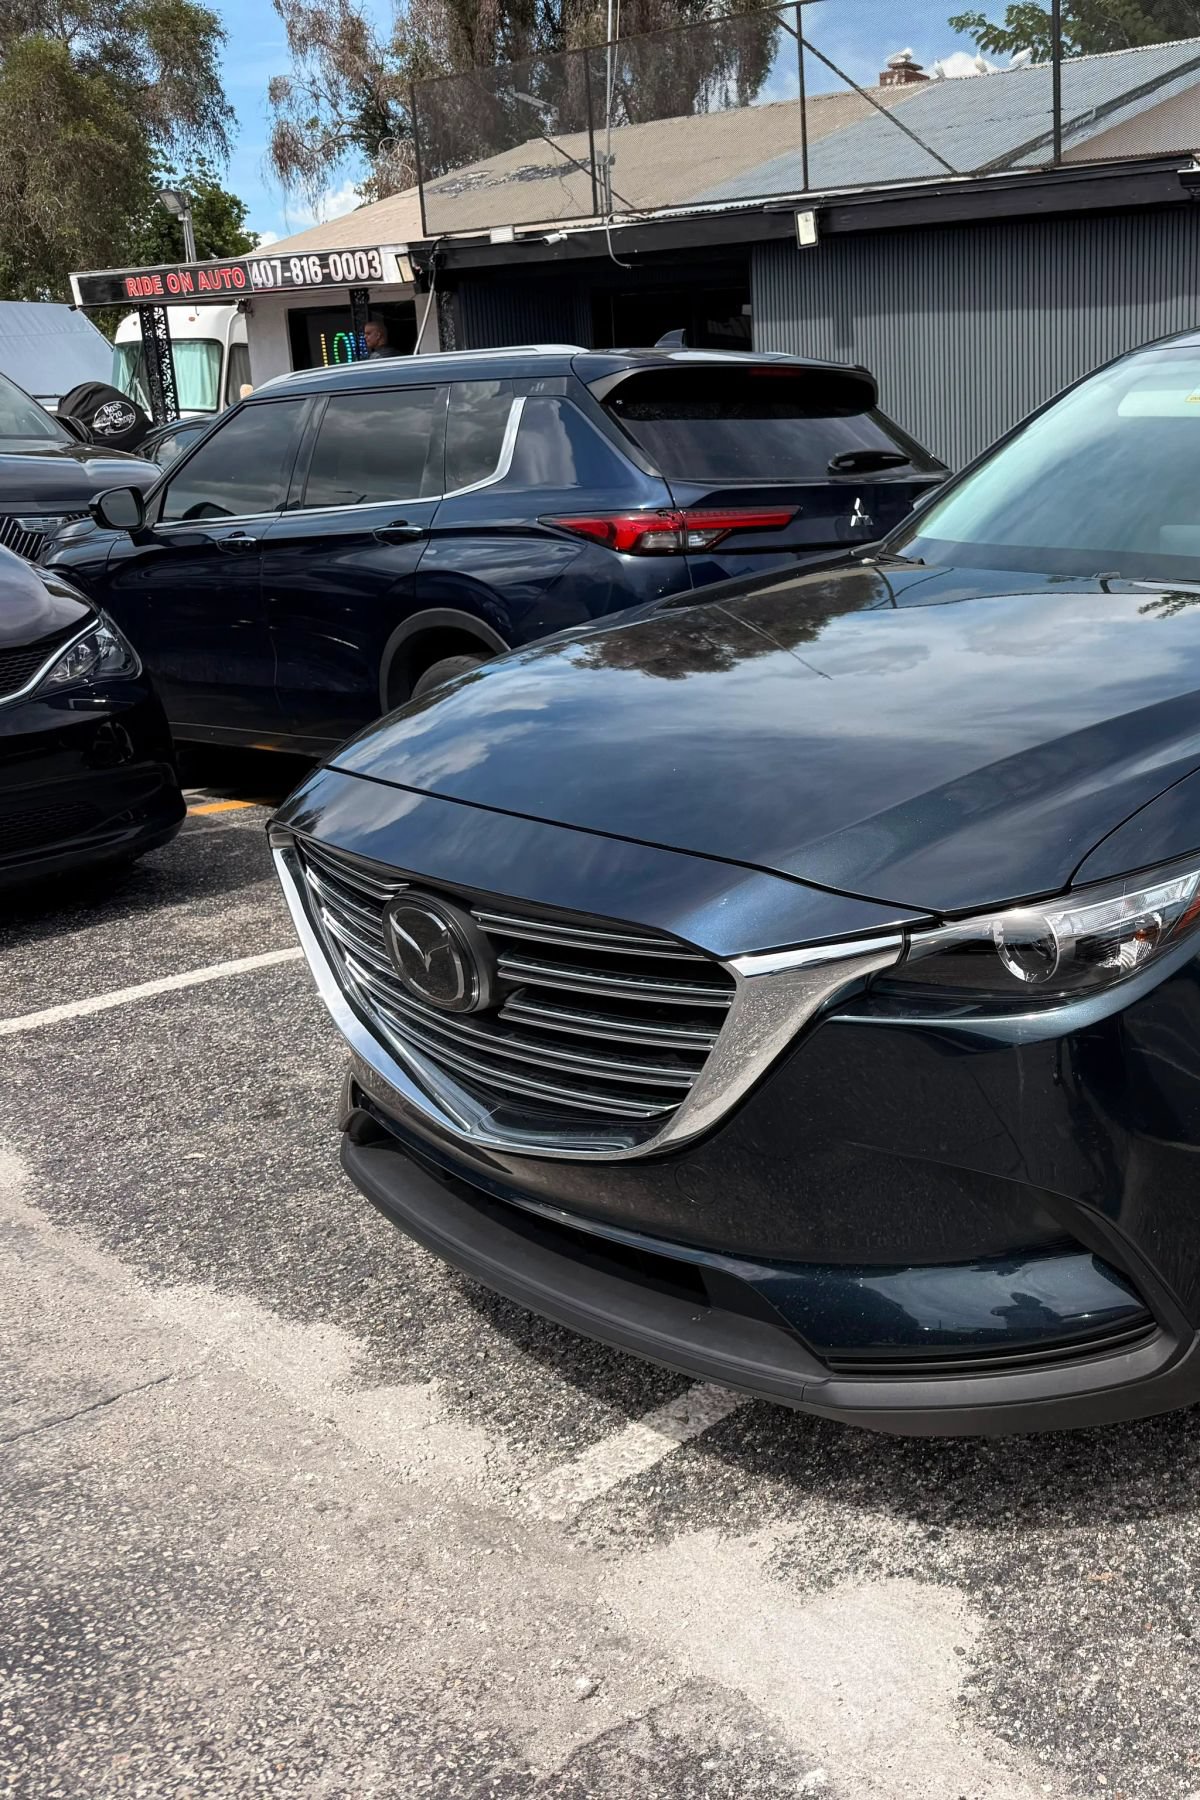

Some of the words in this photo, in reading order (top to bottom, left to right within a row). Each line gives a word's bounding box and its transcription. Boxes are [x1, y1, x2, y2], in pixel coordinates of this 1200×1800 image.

[125, 275, 164, 297] RIDE
[166, 271, 194, 295] ON
[198, 267, 246, 291] AUTO
[250, 249, 382, 289] 407-816-0003
[103, 403, 122, 415] Bass
[110, 410, 123, 422] Pro
[114, 412, 136, 428] Shops
